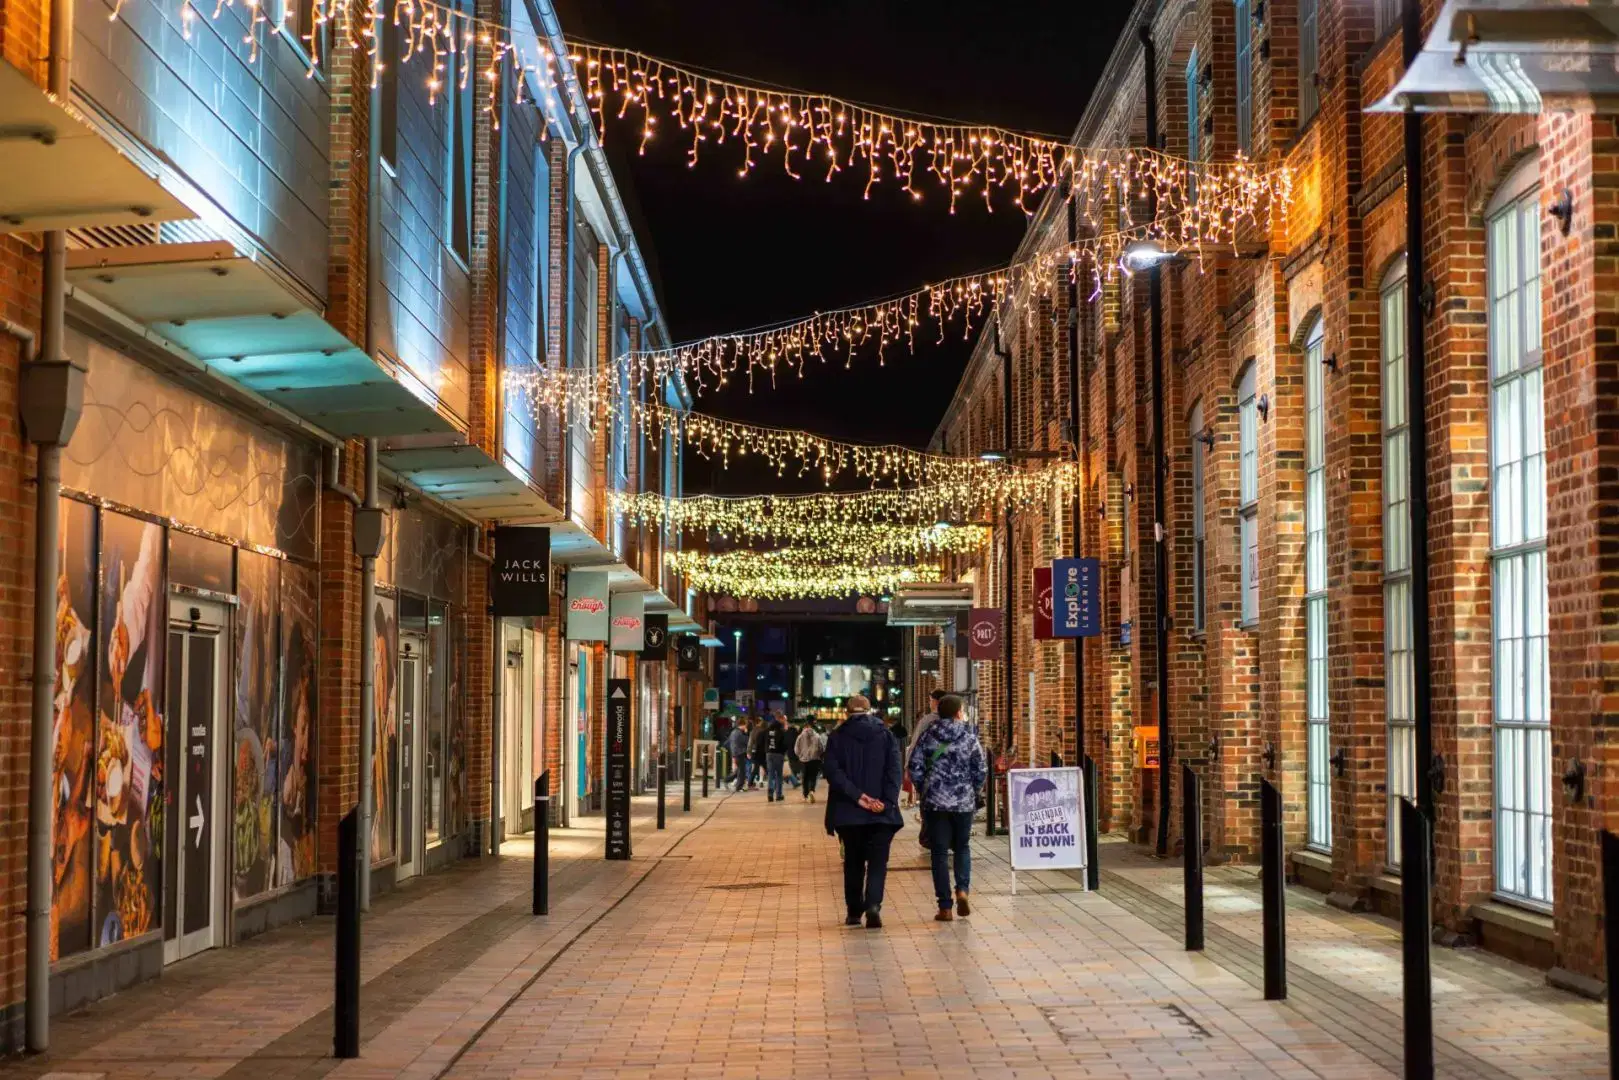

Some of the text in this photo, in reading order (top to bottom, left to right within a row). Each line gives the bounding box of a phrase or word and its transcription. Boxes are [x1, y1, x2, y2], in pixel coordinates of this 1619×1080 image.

[504, 559, 541, 569] JACK
[501, 572, 546, 583] WILLS
[571, 600, 605, 613] Enough
[976, 628, 992, 639] PRET
[615, 705, 623, 744] cineworld
[1029, 807, 1063, 822] CALENDAR
[1024, 823, 1069, 835] IS BACK
[1019, 835, 1075, 848] IN TOWN!
